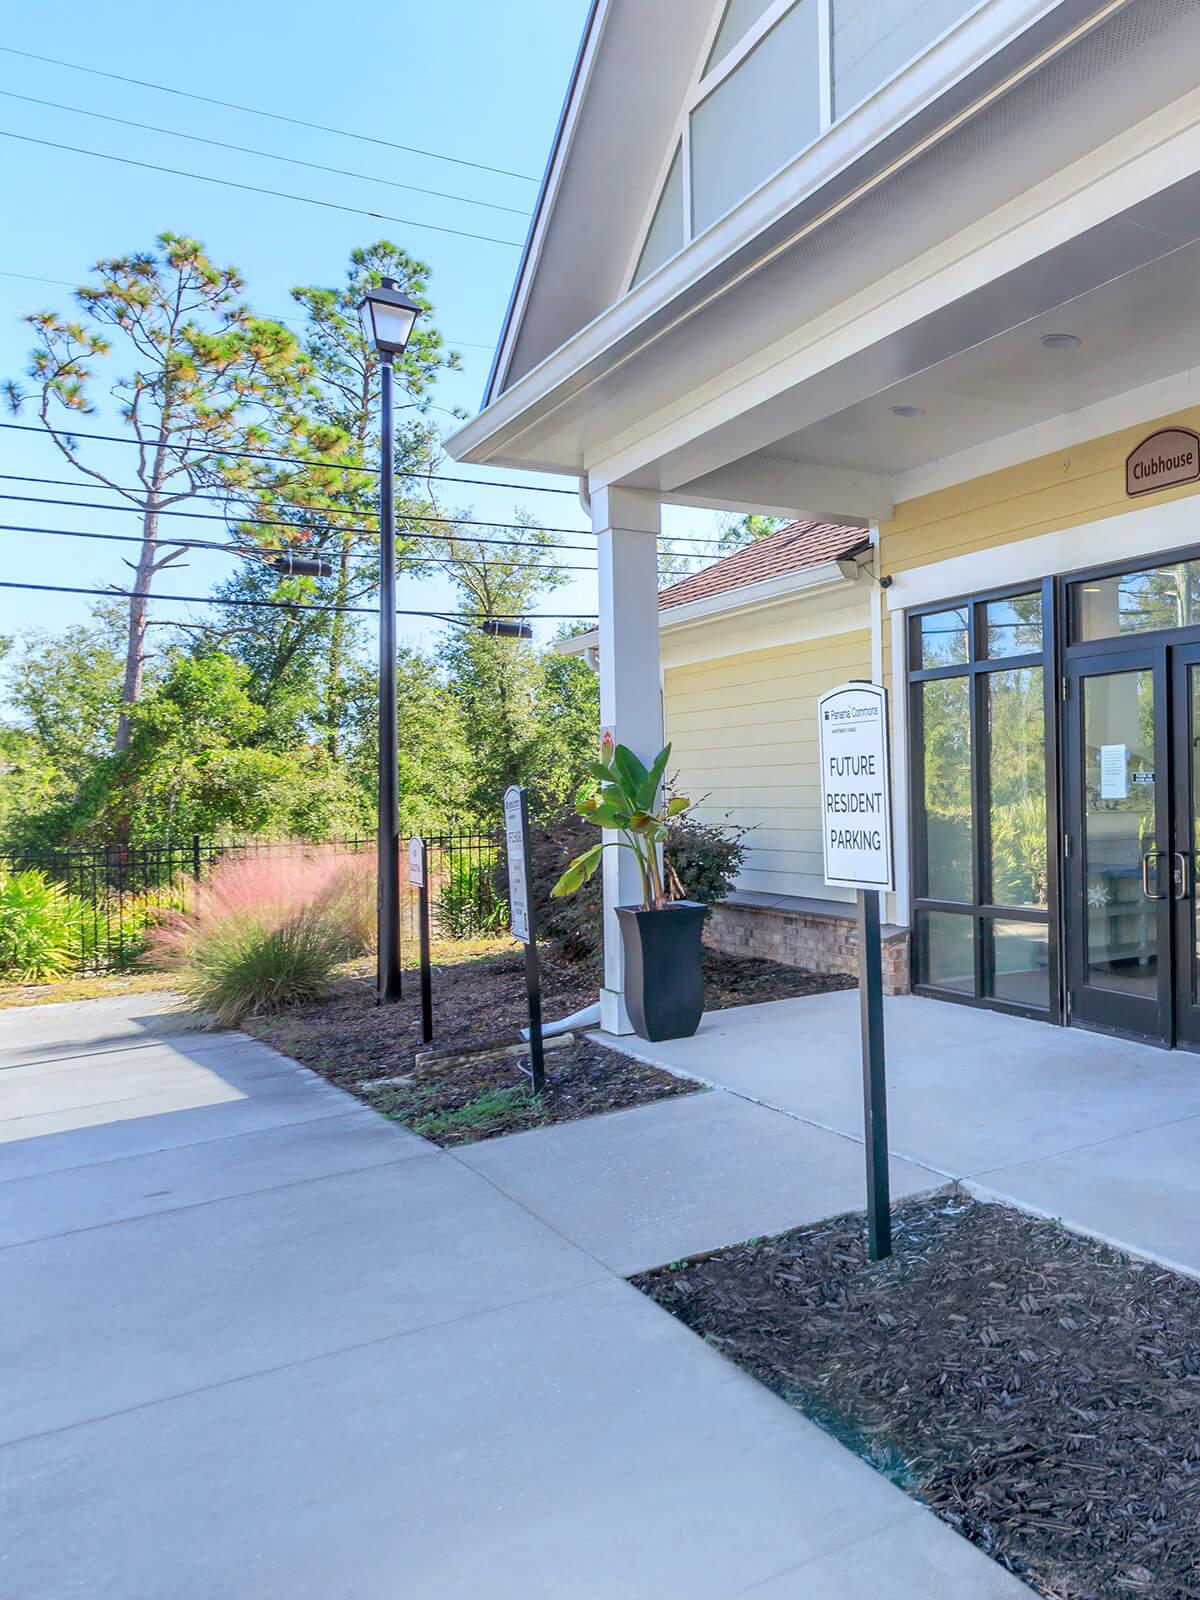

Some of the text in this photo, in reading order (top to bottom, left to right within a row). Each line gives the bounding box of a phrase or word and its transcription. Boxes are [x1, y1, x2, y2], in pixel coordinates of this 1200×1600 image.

[1133, 451, 1193, 480] Clubhouse
[831, 706, 879, 720] Panama Commons
[829, 755, 876, 776] FUTURE
[826, 792, 882, 814] RESIDENT
[830, 829, 881, 851] PARKING
